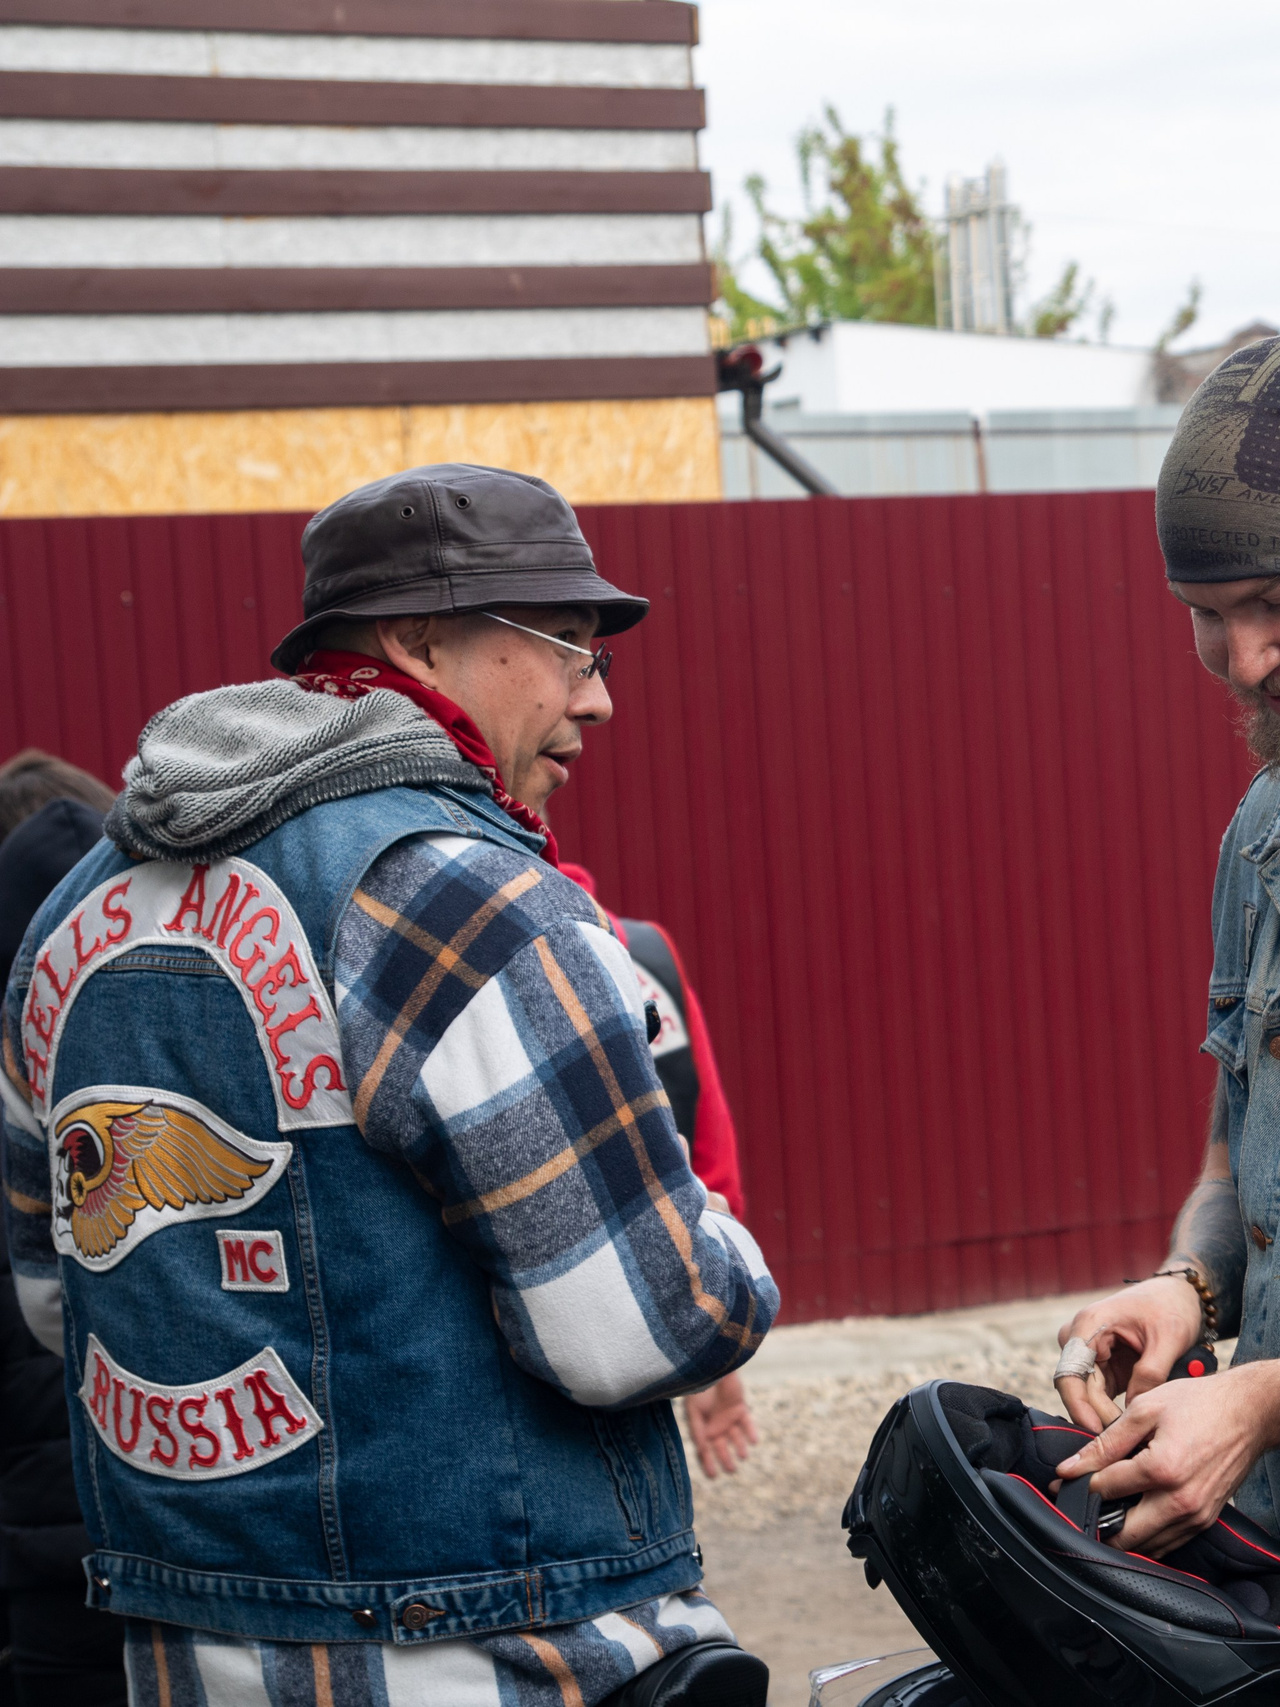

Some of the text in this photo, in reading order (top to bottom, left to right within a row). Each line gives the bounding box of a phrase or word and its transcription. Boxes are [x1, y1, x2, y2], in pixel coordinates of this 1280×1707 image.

[1176, 468, 1236, 495] DUST
[1165, 525, 1260, 547] PROTECTED
[25, 863, 347, 1110] HELLS ANGELS
[223, 1239, 278, 1283] MC
[90, 1351, 307, 1470] RUSSIA
